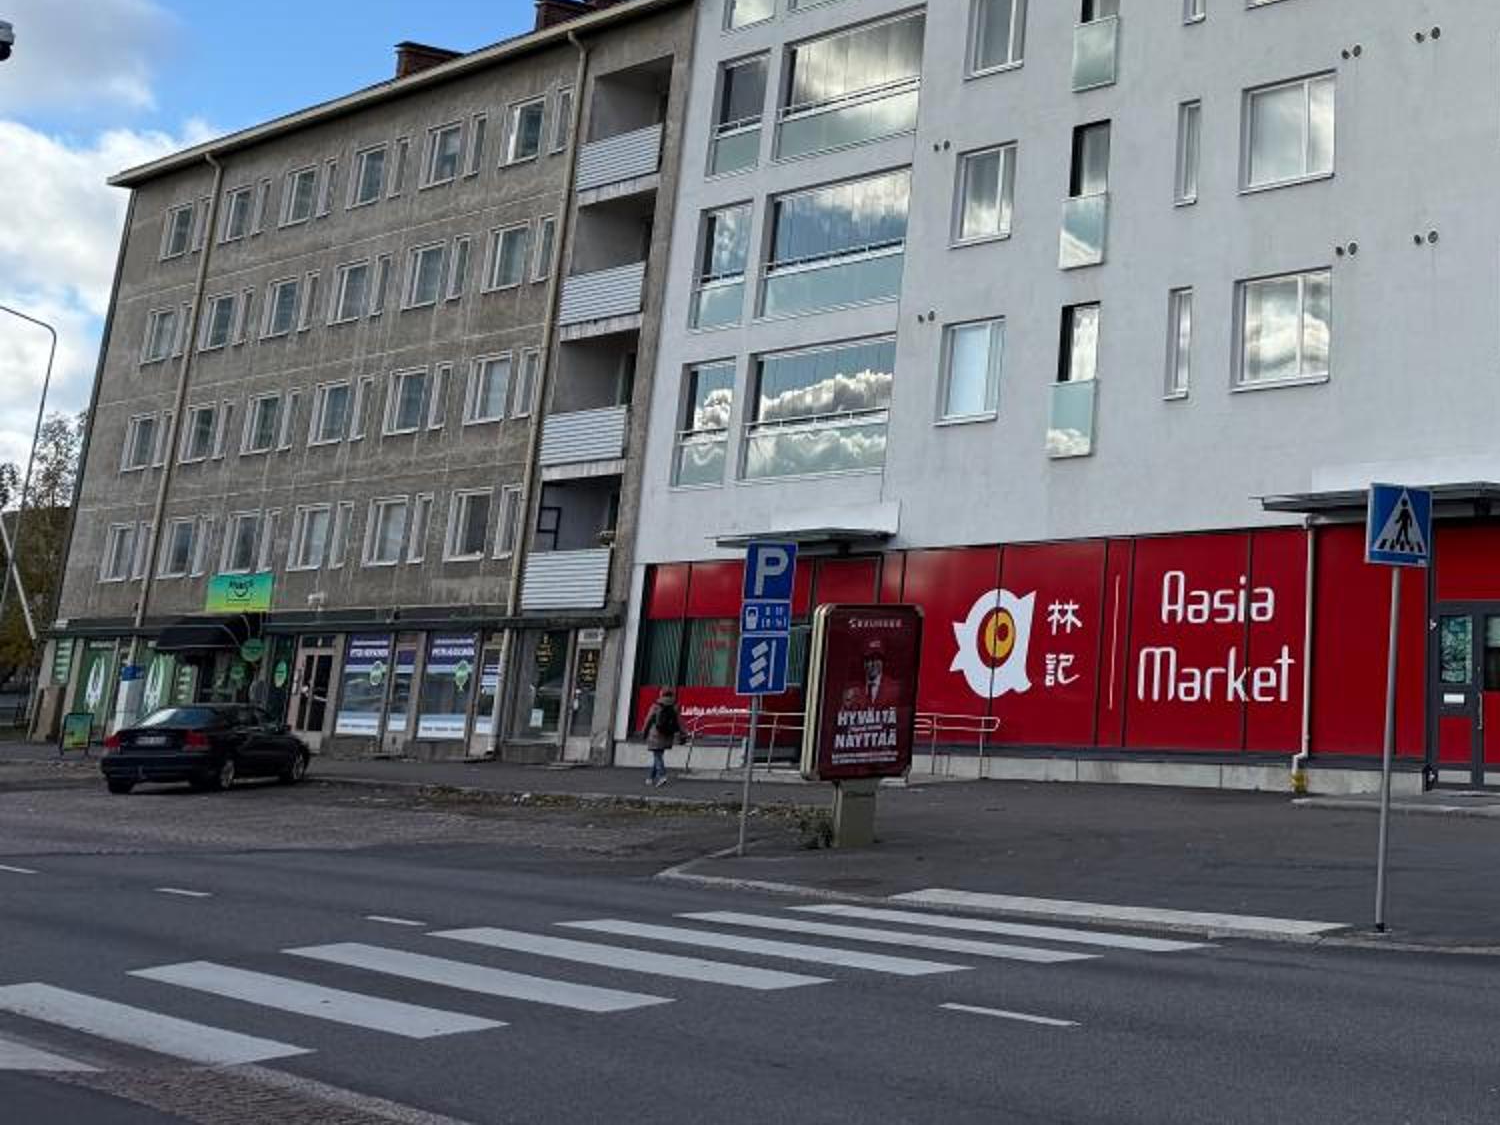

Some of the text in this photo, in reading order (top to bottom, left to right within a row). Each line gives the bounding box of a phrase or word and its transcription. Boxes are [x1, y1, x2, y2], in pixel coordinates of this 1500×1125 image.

[754, 547, 789, 596] P
[1161, 570, 1275, 624] Aasia
[1045, 599, 1083, 687] 林記
[1137, 645, 1295, 702] Market
